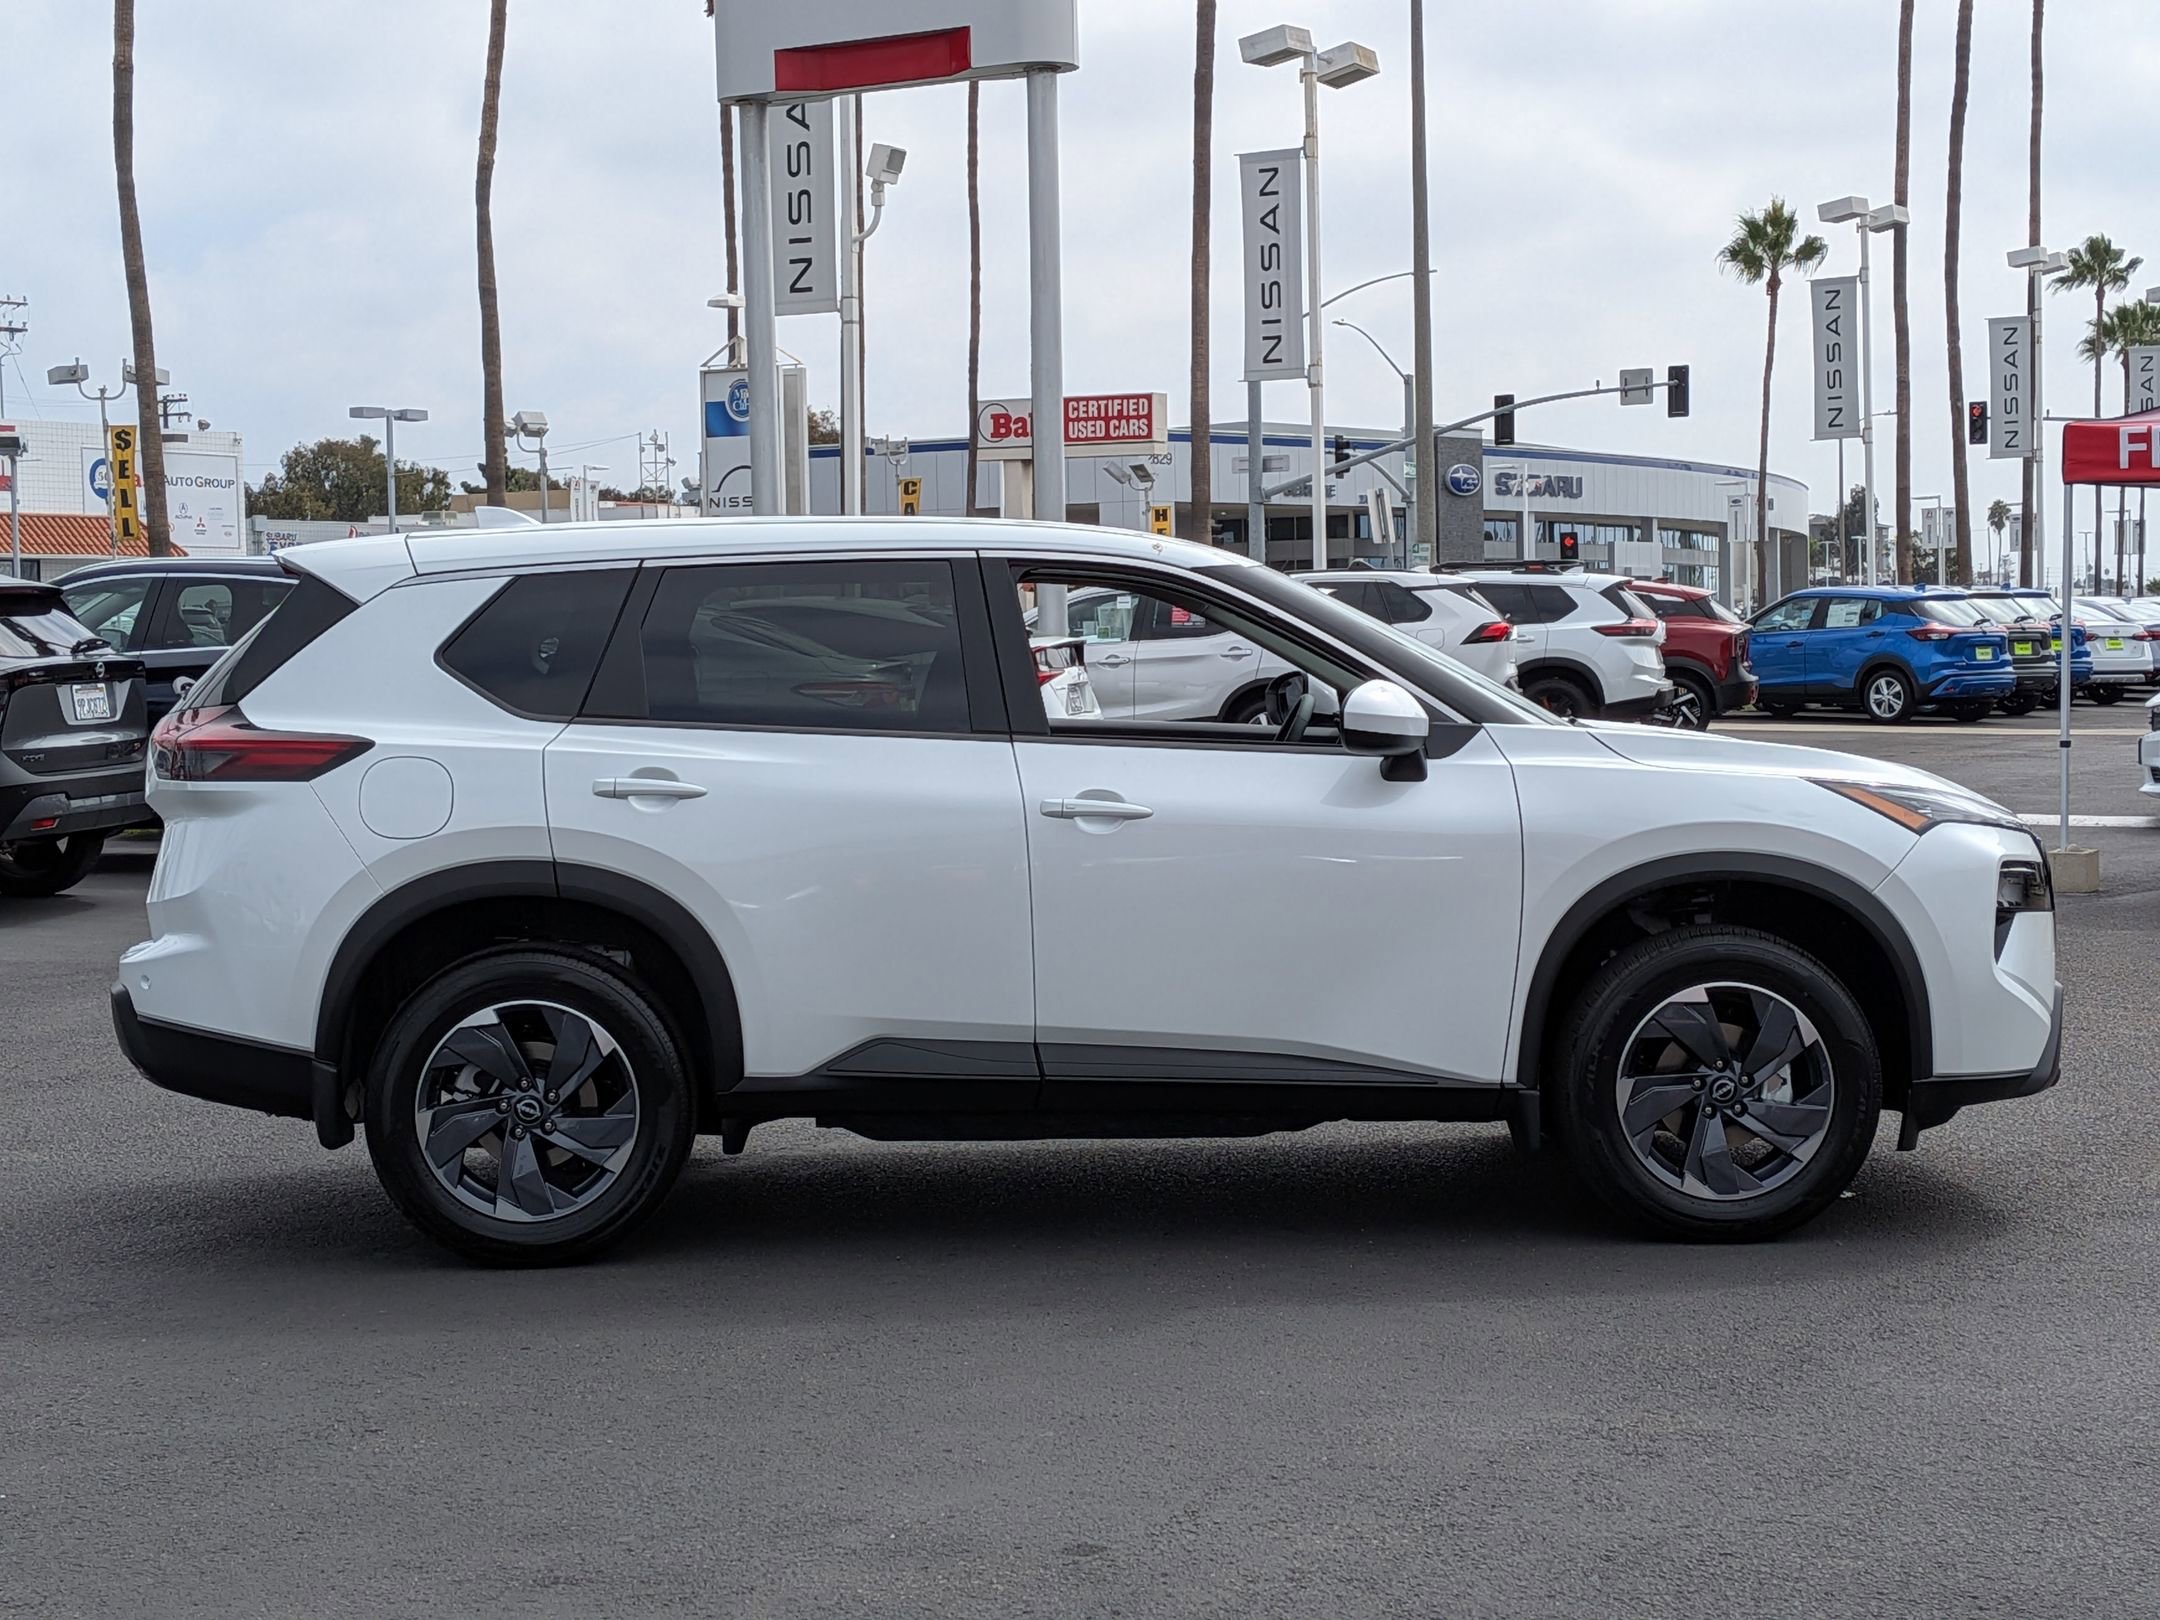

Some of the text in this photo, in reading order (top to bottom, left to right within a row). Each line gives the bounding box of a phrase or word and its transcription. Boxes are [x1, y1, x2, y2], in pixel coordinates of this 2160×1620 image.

[786, 102, 813, 294] NISSA
[1258, 166, 1283, 364] NISSAN
[1825, 288, 1843, 428] NISSAN
[2003, 326, 2019, 449] NISSAN
[2140, 355, 2154, 412] SAN
[1068, 398, 1149, 419] CERTIFIED
[1068, 418, 1149, 439] USED CARS
[709, 496, 752, 508] NISS
